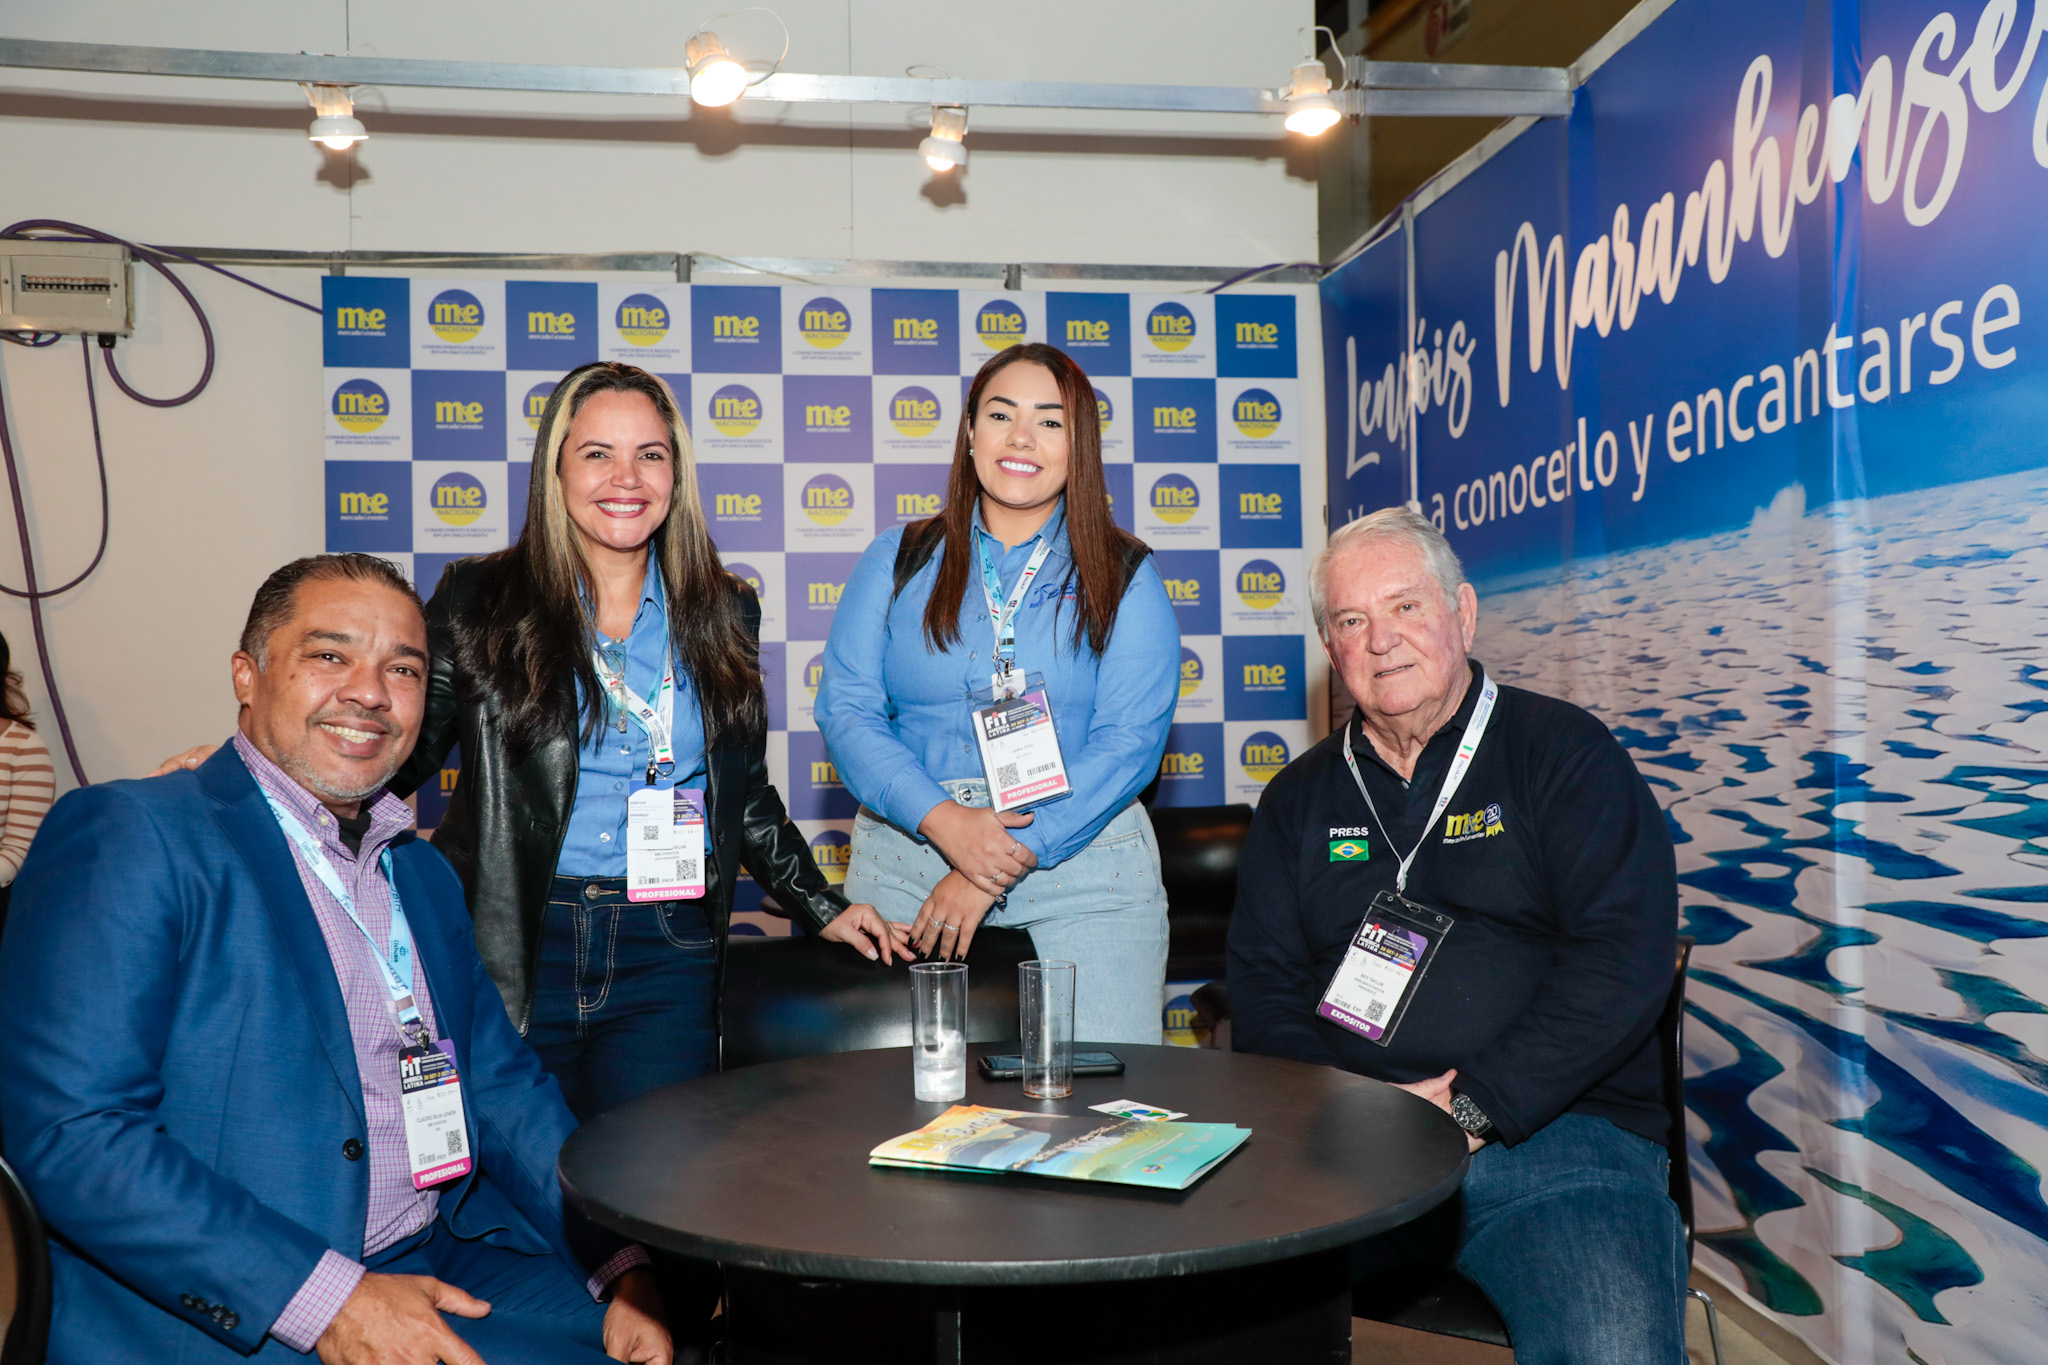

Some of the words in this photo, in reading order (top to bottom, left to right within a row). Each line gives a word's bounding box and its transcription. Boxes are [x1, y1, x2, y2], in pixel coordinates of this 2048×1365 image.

[1495, 0, 2048, 407] Maranhense
[1454, 416, 1618, 530] conocerlo
[1628, 414, 1654, 502] y
[1666, 283, 2020, 463] encantarse
[988, 728, 1011, 737] LATINA
[1007, 779, 1058, 800] PROFESIONAL
[1486, 808, 1498, 818] 20
[1444, 809, 1485, 837] m&e
[1329, 827, 1369, 838] PRESS
[636, 889, 696, 899] PROFESIONAL
[1357, 940, 1378, 954] LATINA
[1369, 977, 1384, 986] TAYLOR
[1330, 1008, 1370, 1033] EXPOSITOR
[403, 1081, 424, 1090] LATINA
[420, 1162, 466, 1184] PROFESIONAL
